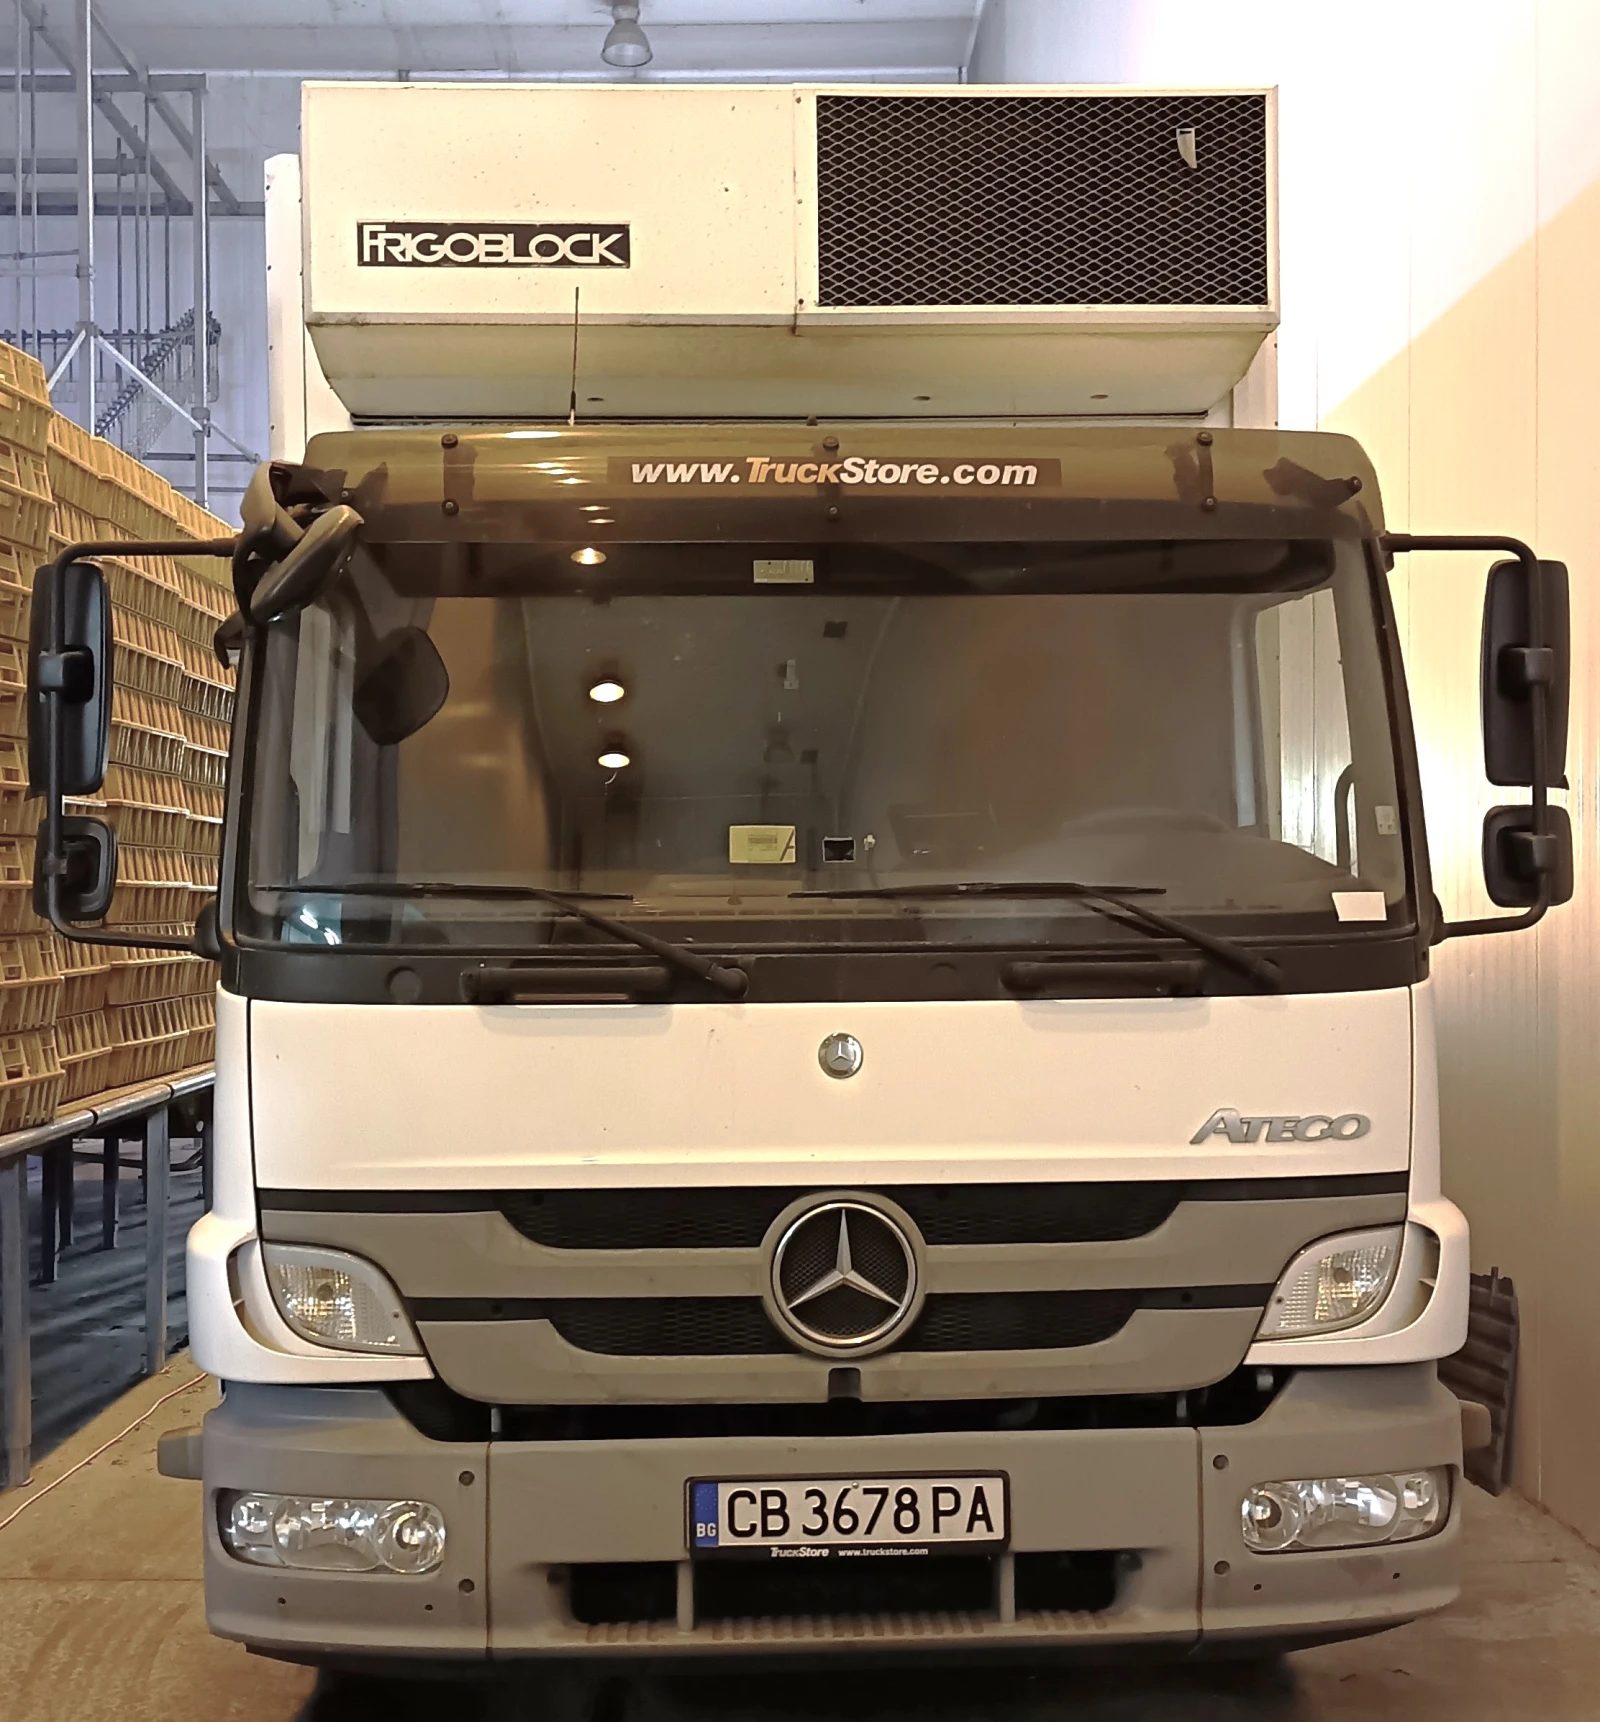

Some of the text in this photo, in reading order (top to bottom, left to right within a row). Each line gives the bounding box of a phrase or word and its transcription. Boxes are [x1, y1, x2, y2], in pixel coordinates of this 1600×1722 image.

[362, 224, 626, 264] FRIGOBLOCK
[1189, 1107, 1371, 1145] ATEGO
[696, 1523, 717, 1537] BG
[728, 1485, 995, 1538] CB 3678 PA
[838, 1546, 929, 1556] www.truckstore.com
